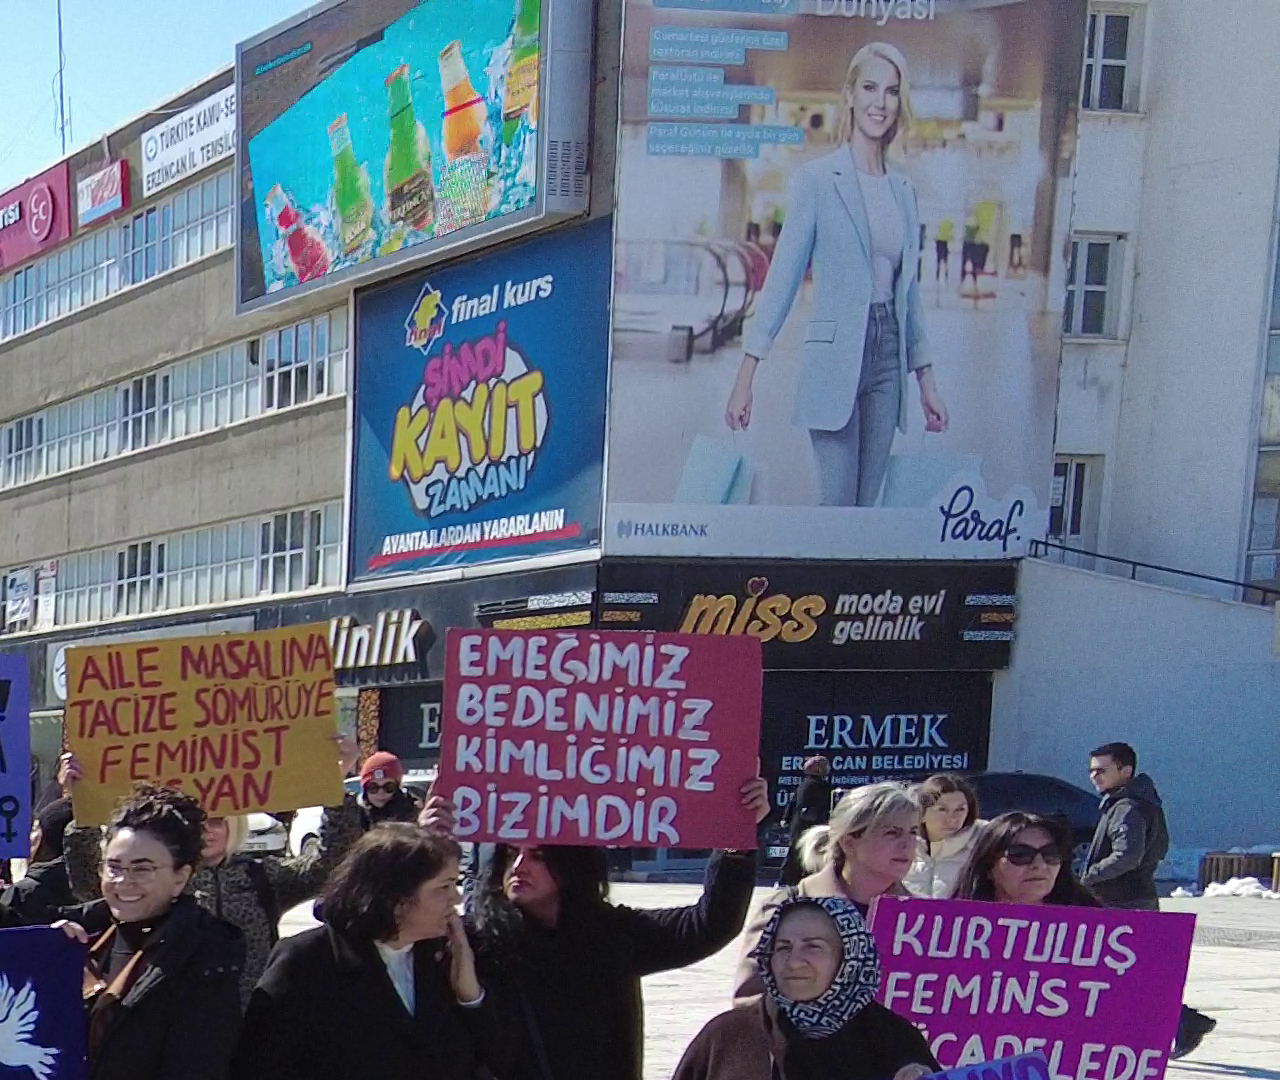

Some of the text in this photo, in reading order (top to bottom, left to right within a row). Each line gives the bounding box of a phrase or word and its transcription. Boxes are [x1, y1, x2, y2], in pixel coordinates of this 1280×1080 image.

[195, 93, 236, 133] KAMU-SE
[451, 273, 555, 324] final kurs
[390, 370, 544, 482] KAYIT
[426, 455, 528, 518] ZAMANI
[382, 508, 566, 556] AVANTAJLARDAN YARARLANIN
[633, 522, 709, 537] HALKBANK
[328, 608, 424, 671] linlik
[679, 578, 946, 644] miss moda evi
[831, 615, 927, 646] gelinlik
[77, 632, 332, 694] AİLE MASALINA
[458, 632, 691, 690] EMEĞİMİZ
[69, 677, 335, 739] TACİZE SÖMÜRÜYE
[455, 683, 715, 742] BEDENİMİZ
[803, 713, 949, 750] ERMEK
[98, 724, 291, 785] FEMİNİST
[781, 751, 970, 771] ERCAN BELEDİYESİ
[451, 781, 681, 846] BİZİMDİR
[892, 910, 1139, 977] KURTULUŞ
